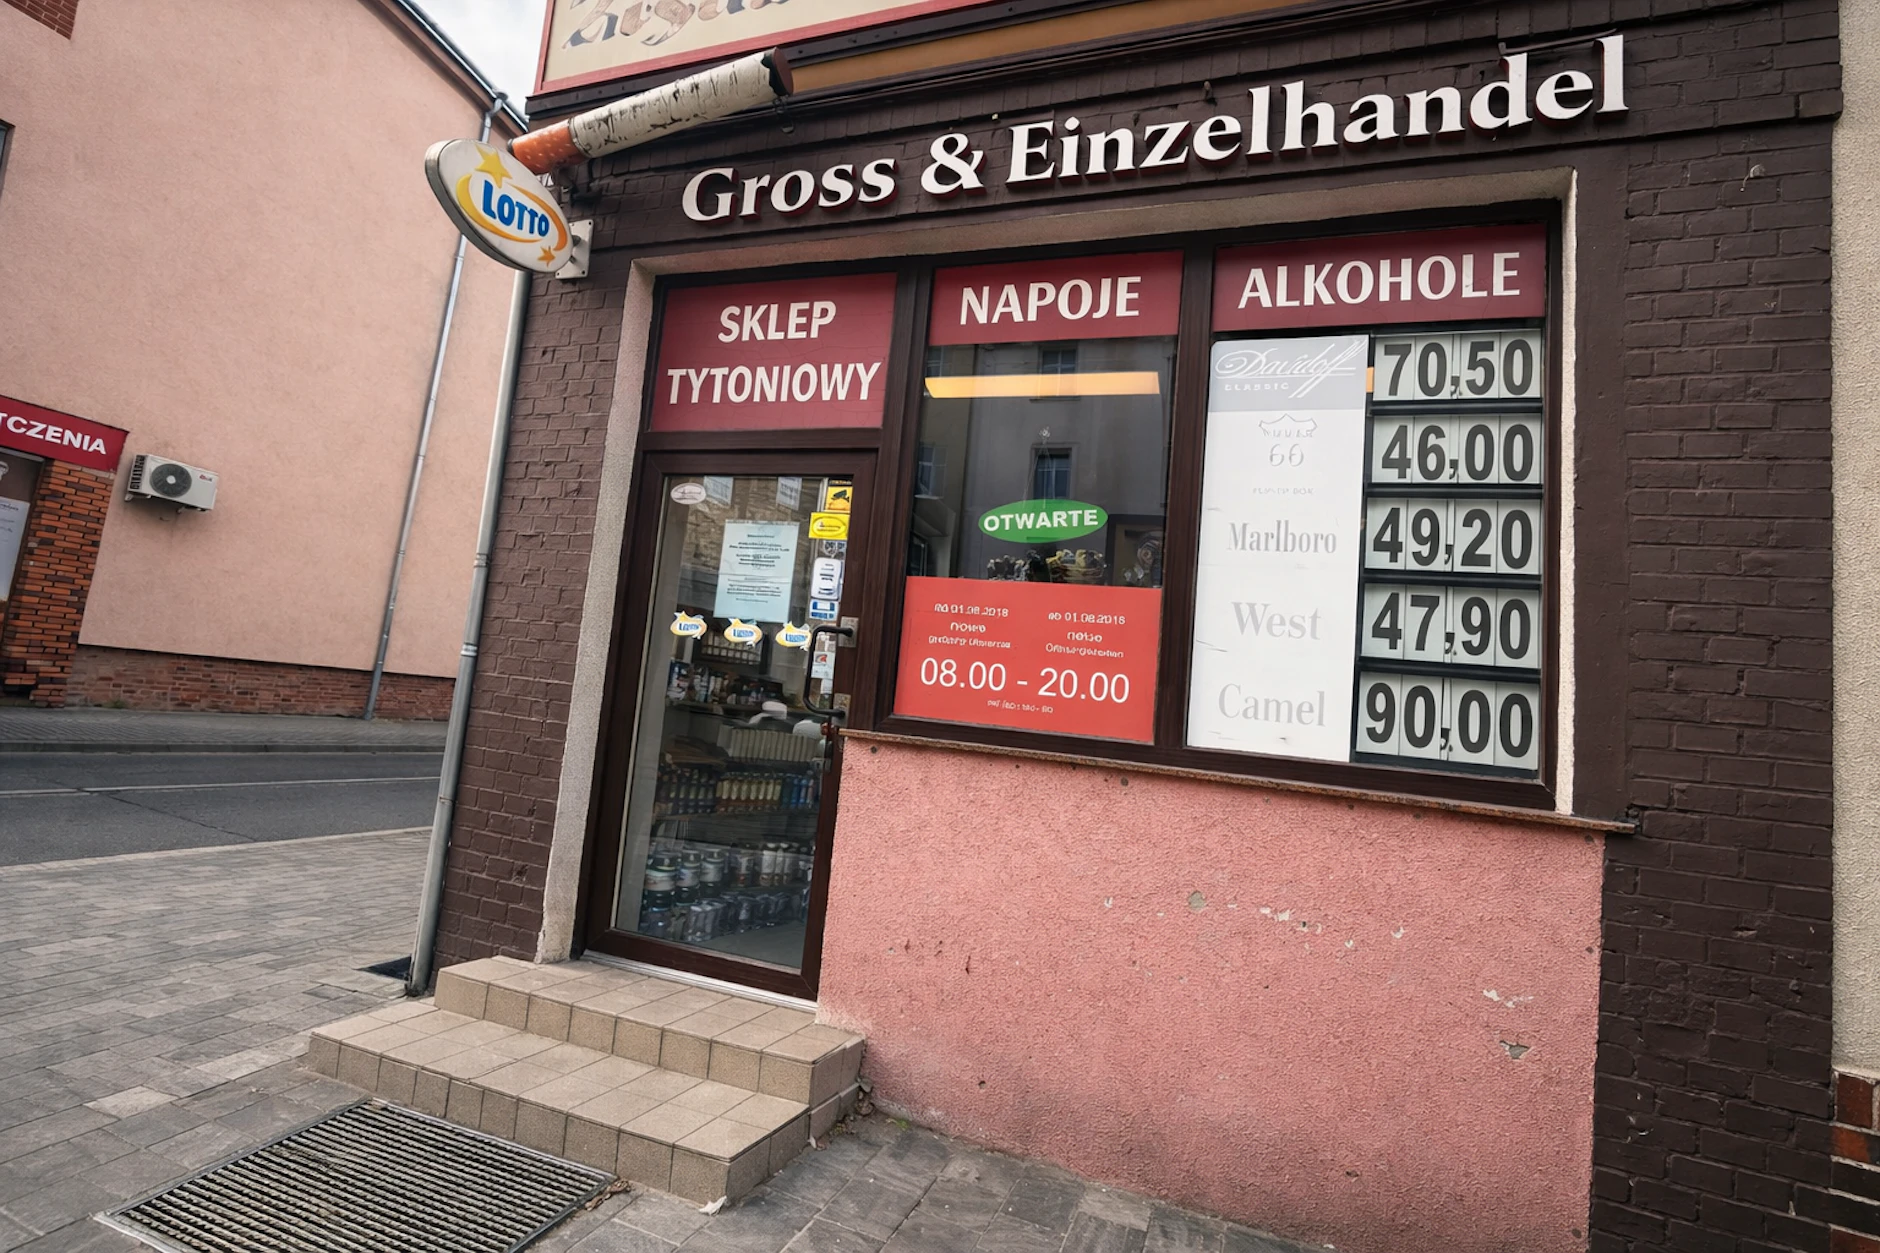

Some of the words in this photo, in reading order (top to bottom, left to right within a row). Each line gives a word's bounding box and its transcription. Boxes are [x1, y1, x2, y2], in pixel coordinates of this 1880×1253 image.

[681, 158, 897, 223] Gross
[920, 132, 984, 196] &
[1004, 34, 1630, 187] Einzelhandel
[482, 179, 549, 237] LOTTO
[959, 275, 1141, 326] NAPOJE
[1237, 251, 1521, 309] ALKOHOLE
[718, 300, 837, 344] SKLEP
[667, 362, 882, 405] TYTONIOWY
[1215, 339, 1368, 399] Davidoff
[1384, 339, 1533, 399] 70,50
[1269, 443, 1304, 467] 66
[1381, 423, 1534, 482] 46,00
[983, 509, 1099, 532] OTWARTE
[1227, 520, 1338, 554] Marlboro
[1373, 507, 1533, 570] 49,20
[1231, 601, 1322, 641] West
[1371, 592, 1531, 660] 47,90
[920, 657, 1007, 691] 08.00
[1038, 668, 1130, 703] 20.00
[1218, 683, 1326, 727] Camel
[1365, 682, 1533, 758] 90,00
